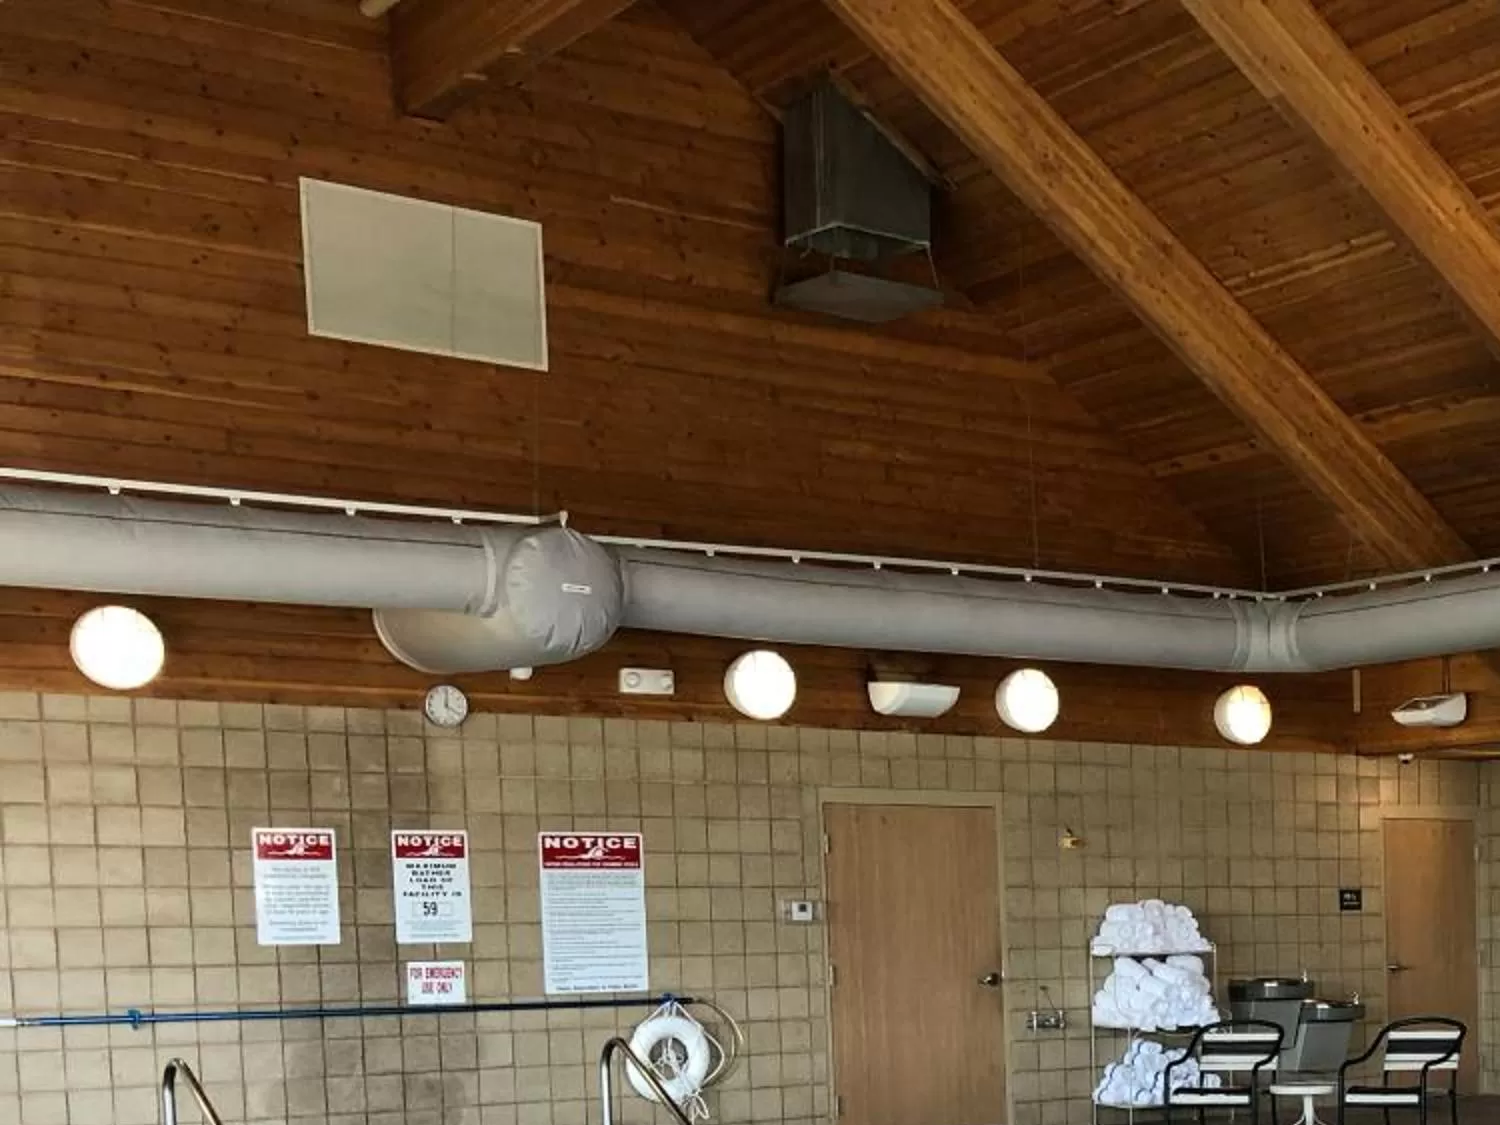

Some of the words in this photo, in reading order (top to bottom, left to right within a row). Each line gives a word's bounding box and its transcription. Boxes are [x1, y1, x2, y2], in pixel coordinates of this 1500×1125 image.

[259, 834, 329, 846] NOTICE
[397, 835, 462, 847] NOTICE
[544, 837, 637, 849] NOTICE
[423, 901, 439, 917] 59
